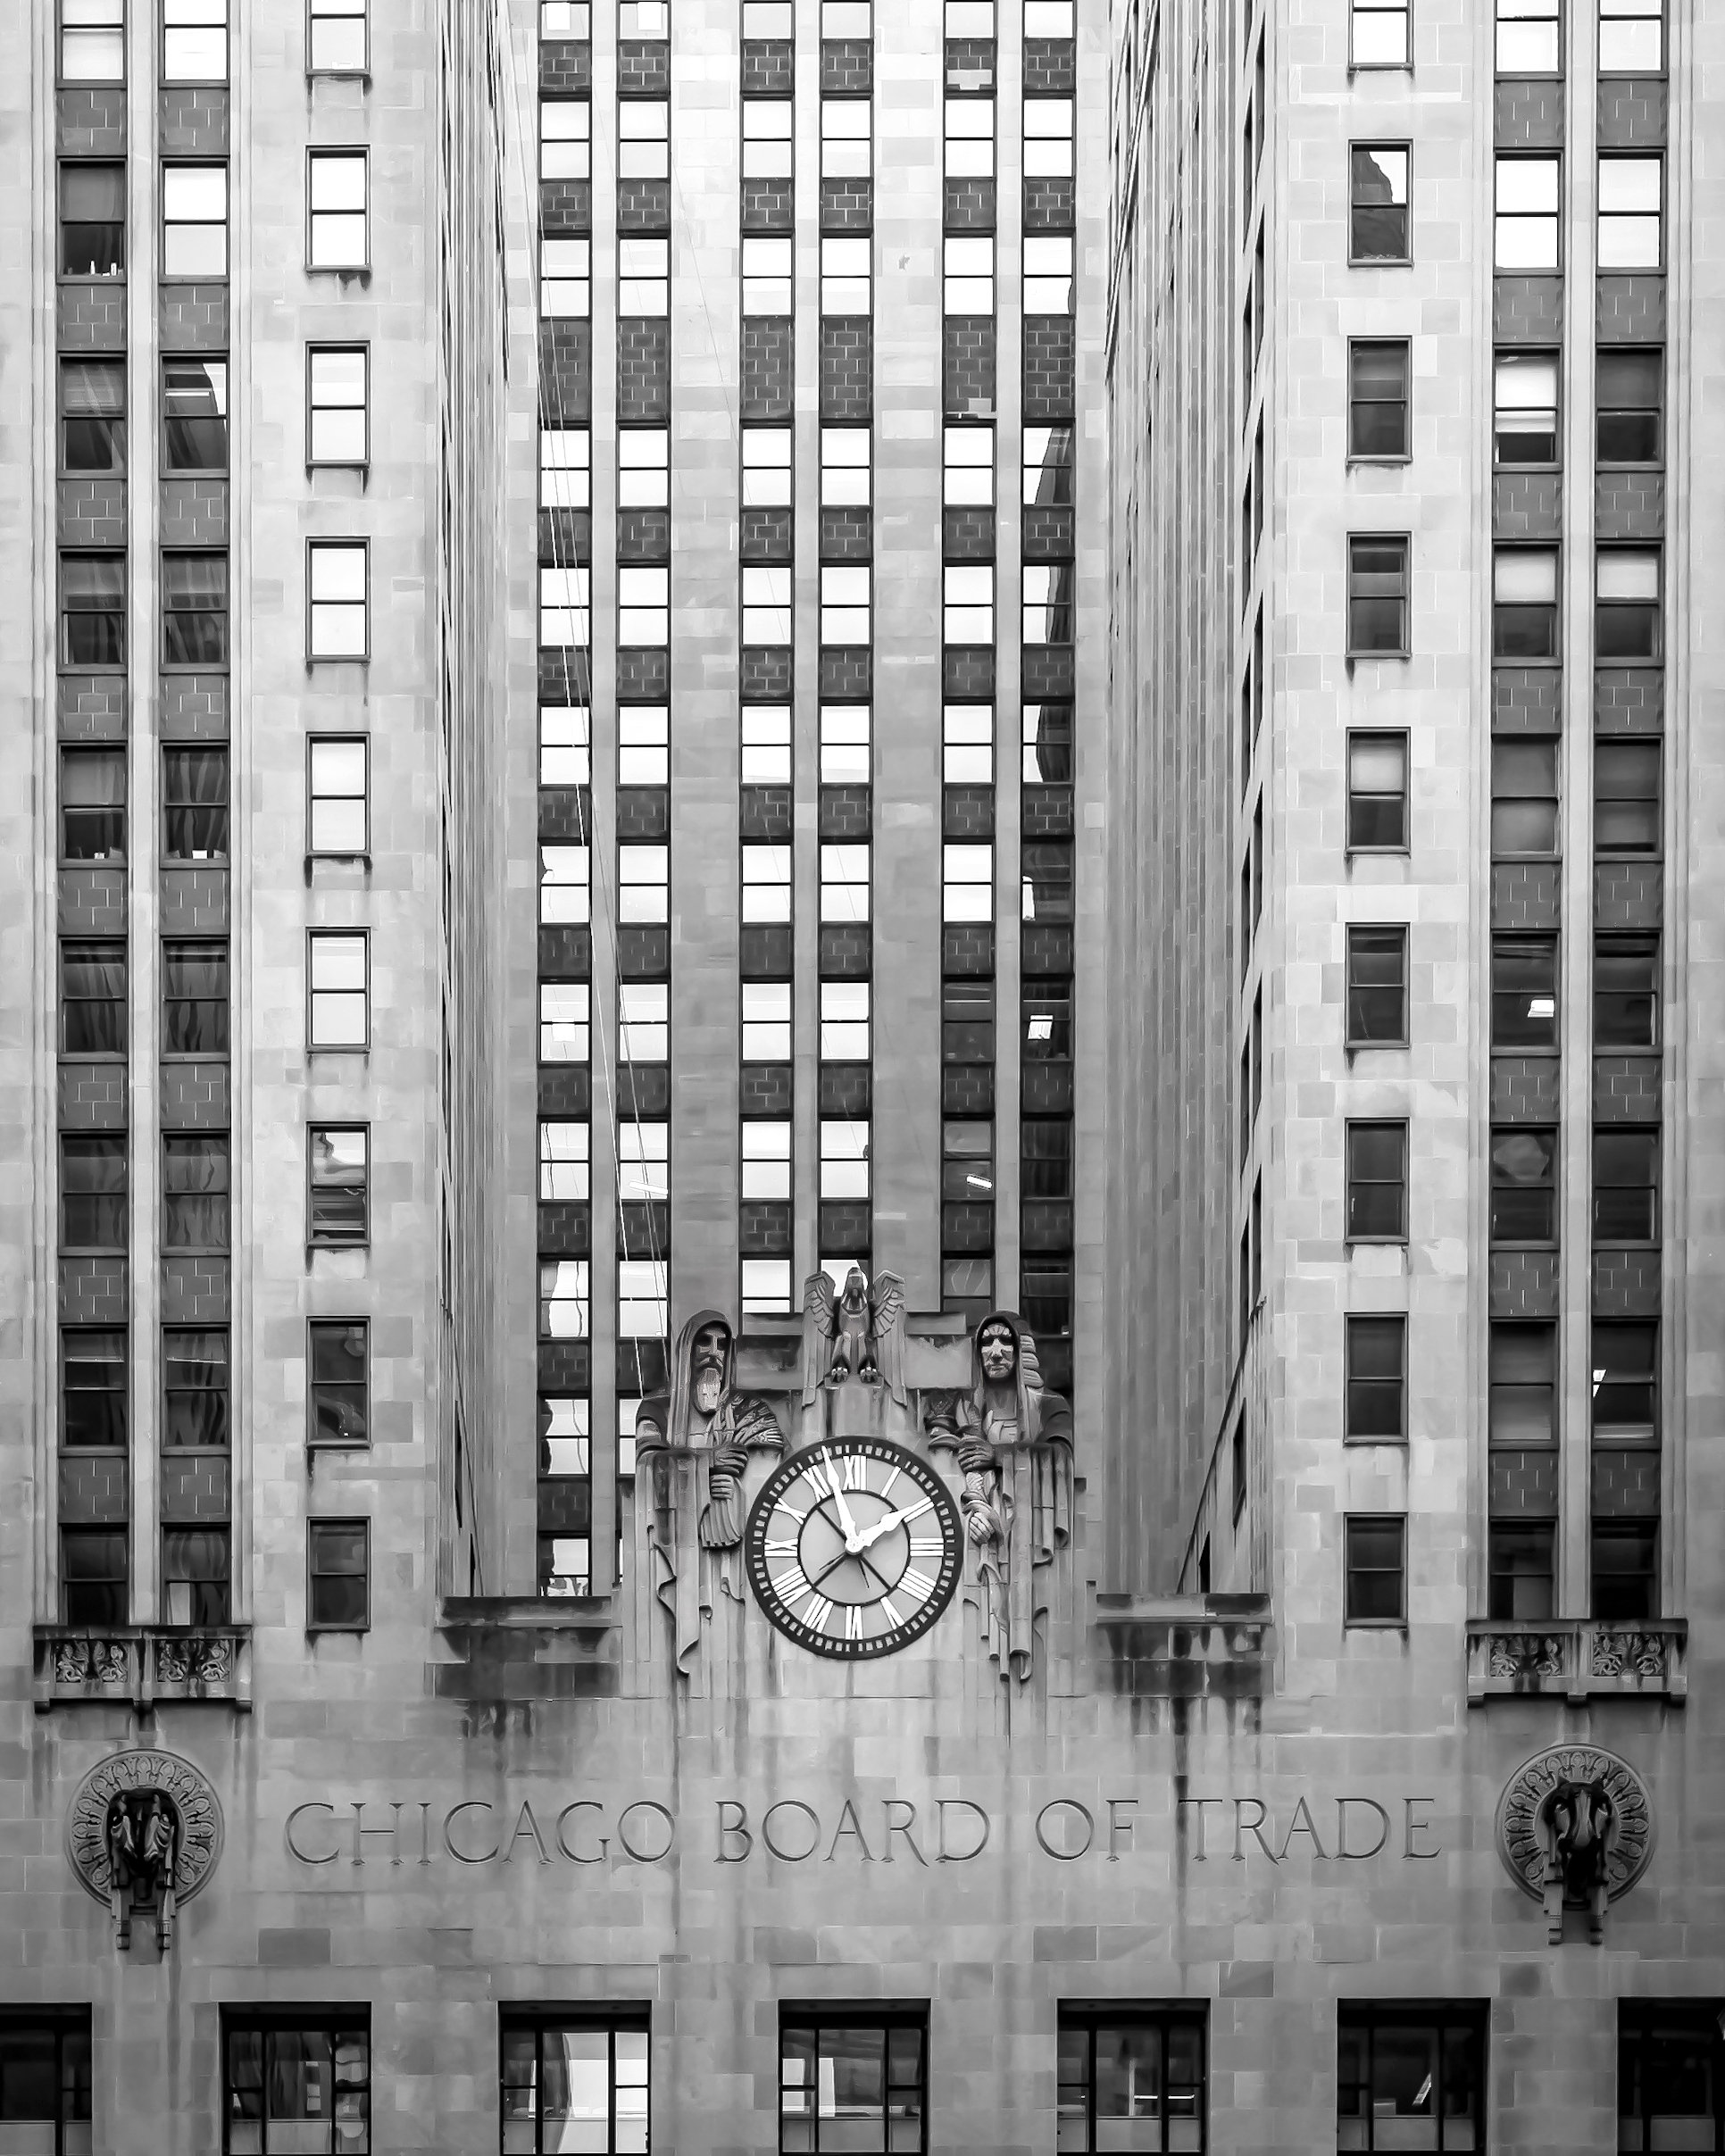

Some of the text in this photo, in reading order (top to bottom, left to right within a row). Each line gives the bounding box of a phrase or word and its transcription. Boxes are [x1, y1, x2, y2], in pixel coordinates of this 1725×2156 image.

[801, 1465, 832, 1503] XI
[843, 1455, 867, 1490] XII
[773, 1497, 807, 1525] X
[764, 1538, 798, 1557] IX
[910, 1537, 944, 1557] III
[771, 1564, 812, 1608] VIII
[897, 1566, 937, 1602] IIII
[801, 1593, 834, 1634] VII
[845, 1606, 863, 1640] VI
[880, 1596, 905, 1630] V
[284, 1795, 1443, 1867] CHICAGO BOARD OF TRADE
